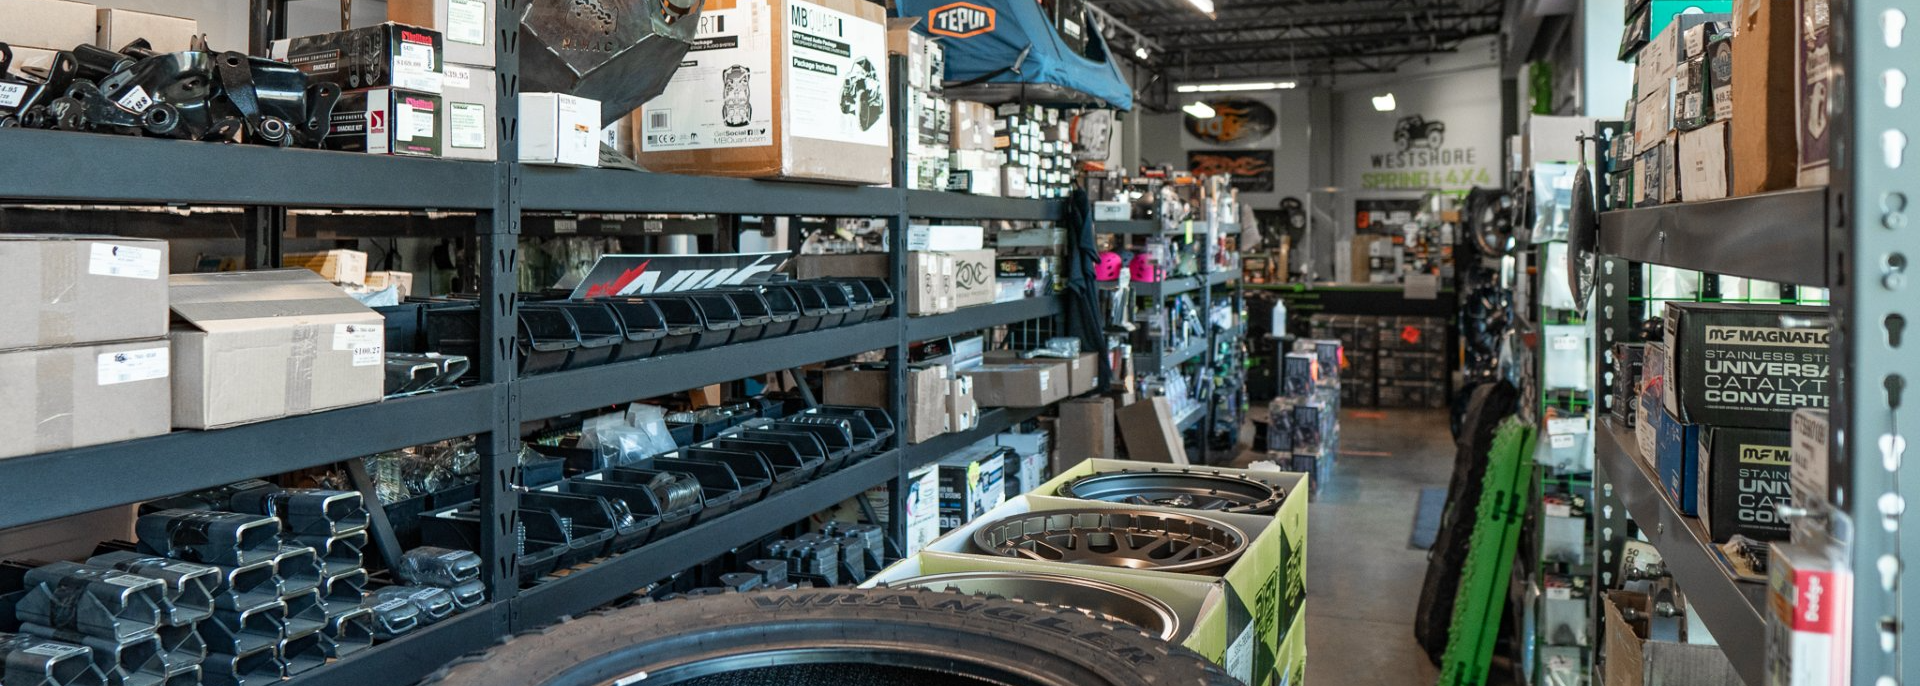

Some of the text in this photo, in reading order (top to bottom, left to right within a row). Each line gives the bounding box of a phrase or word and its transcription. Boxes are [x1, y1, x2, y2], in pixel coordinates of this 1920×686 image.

[938, 7, 985, 32] TEPUI
[1371, 148, 1477, 169] WESTSHORE
[1362, 170, 1428, 189] SPRING
[1705, 350, 1795, 361] STAINLESS
[1804, 575, 1823, 622] Dodge
[752, 592, 1156, 668] WRANGLER
